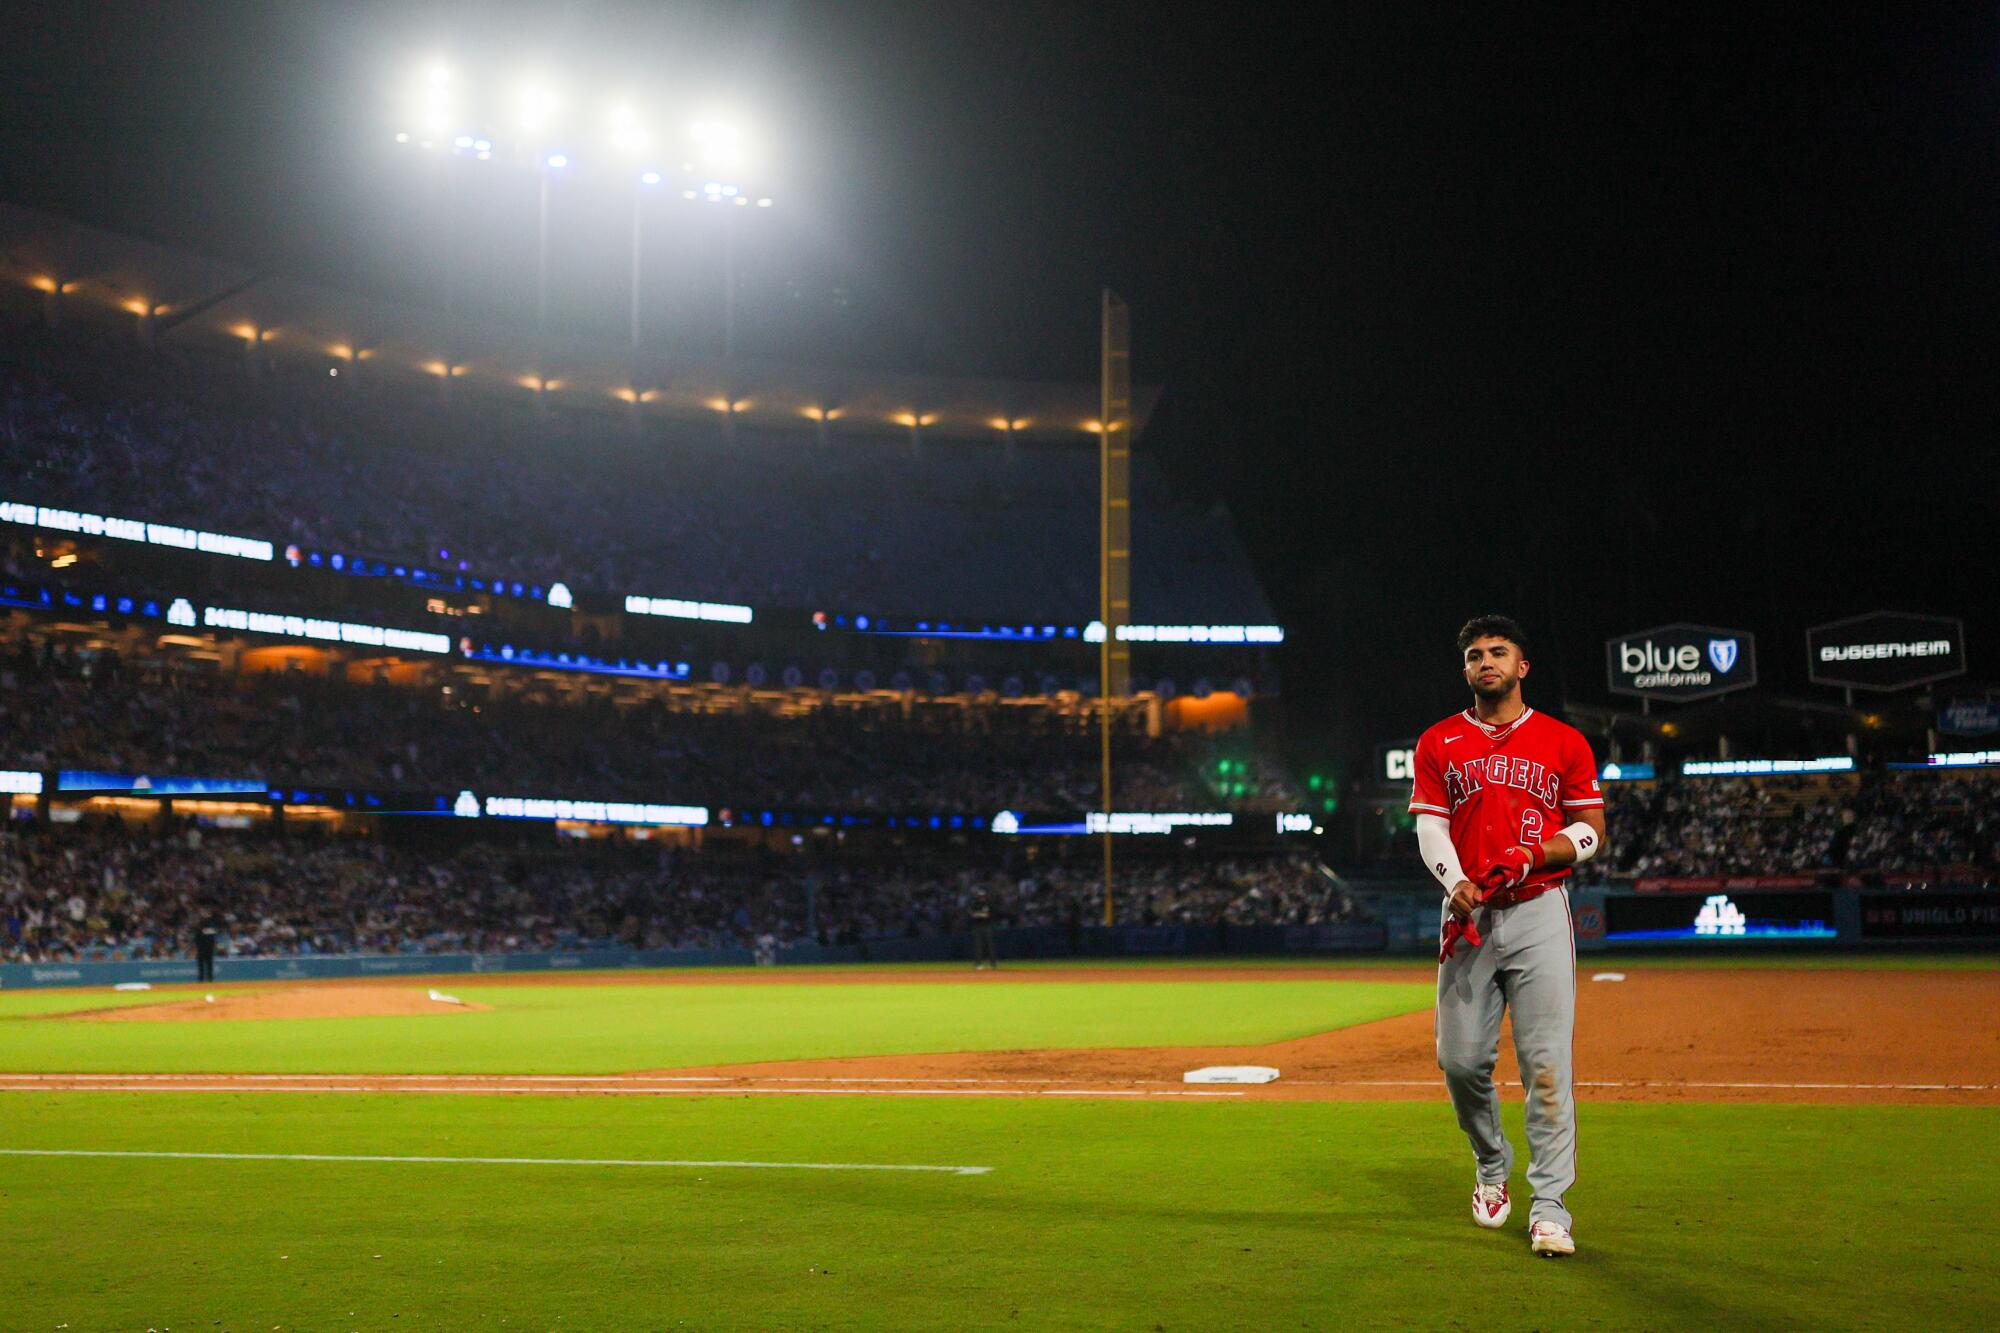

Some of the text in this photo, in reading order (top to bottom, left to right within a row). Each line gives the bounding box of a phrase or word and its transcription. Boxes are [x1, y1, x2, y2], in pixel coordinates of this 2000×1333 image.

[1620, 640, 1700, 673] blue
[1820, 640, 1951, 662] GUGGENHEIM
[1634, 671, 1712, 688] california
[1444, 754, 1560, 815] ANGELS
[1520, 808, 1543, 845] 2
[1579, 835, 1593, 849] 2
[1435, 862, 1448, 878] 2
